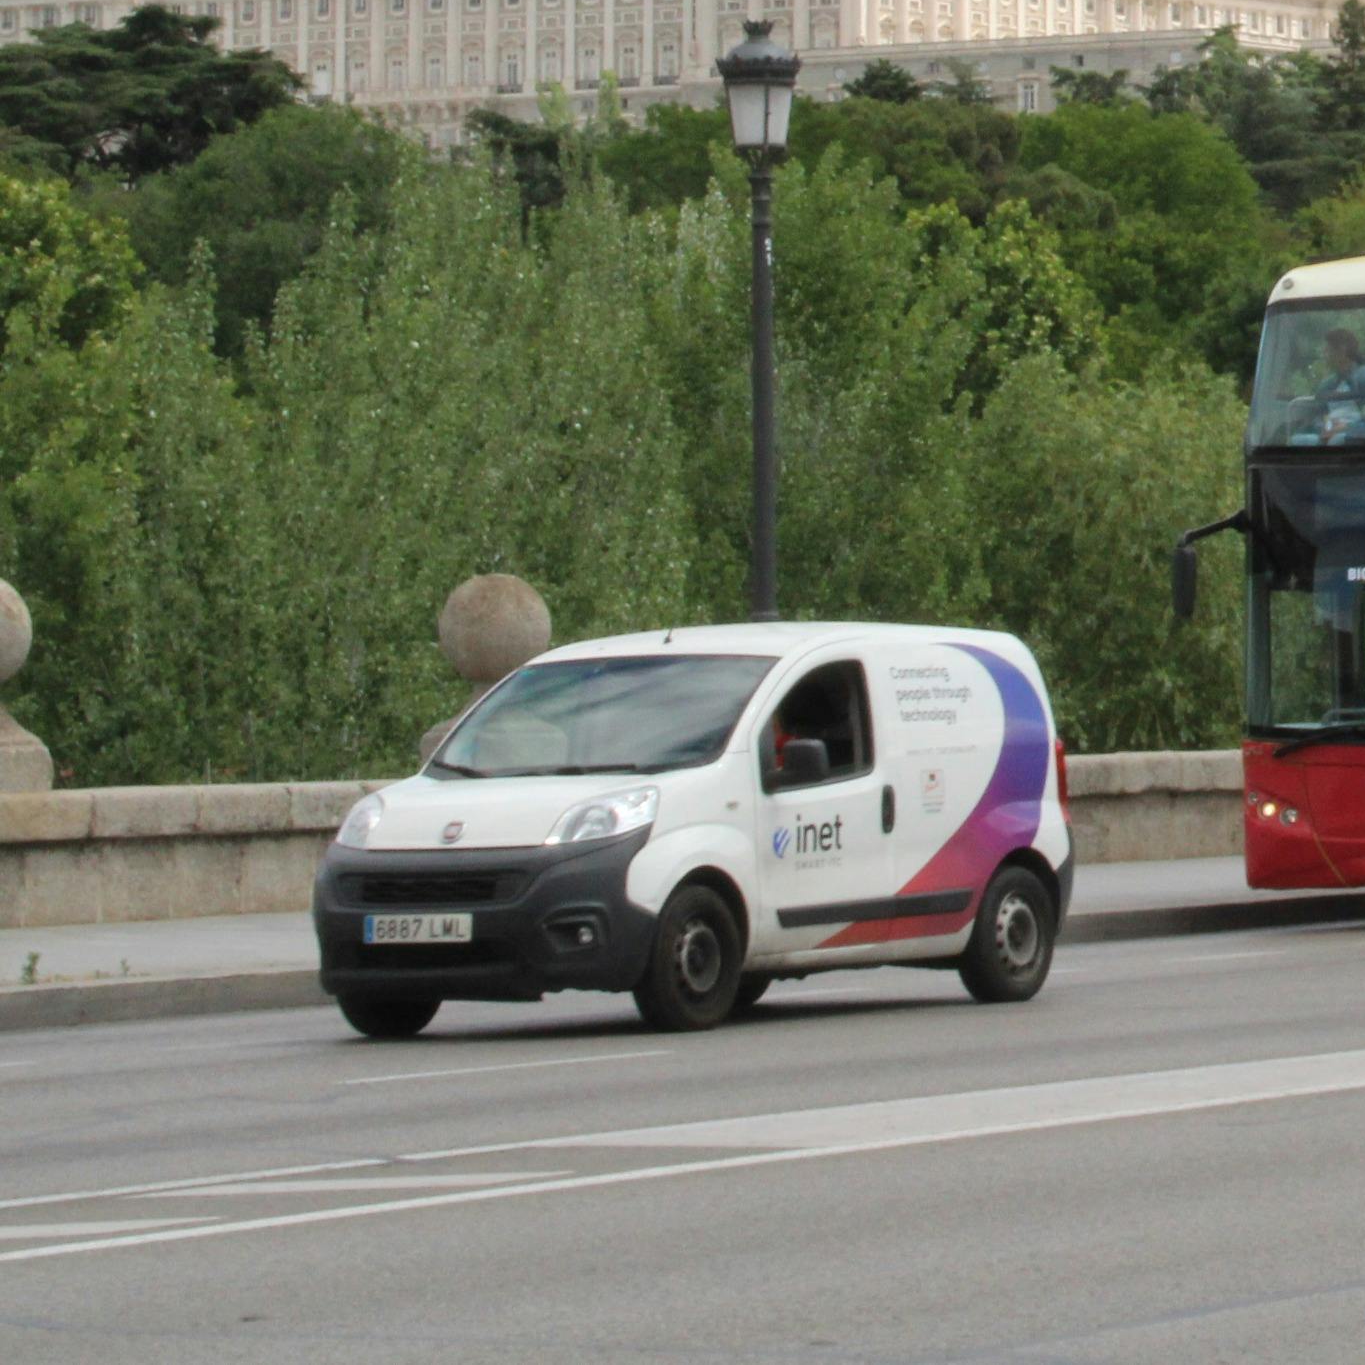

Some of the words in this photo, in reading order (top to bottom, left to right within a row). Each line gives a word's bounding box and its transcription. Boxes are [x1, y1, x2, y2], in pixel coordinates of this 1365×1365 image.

[889, 666, 951, 682] Connecting
[896, 688, 930, 705] people
[932, 686, 972, 703] through
[900, 708, 957, 725] technology
[796, 814, 842, 852] inet
[376, 918, 423, 939] 6887
[428, 918, 465, 938] LML
